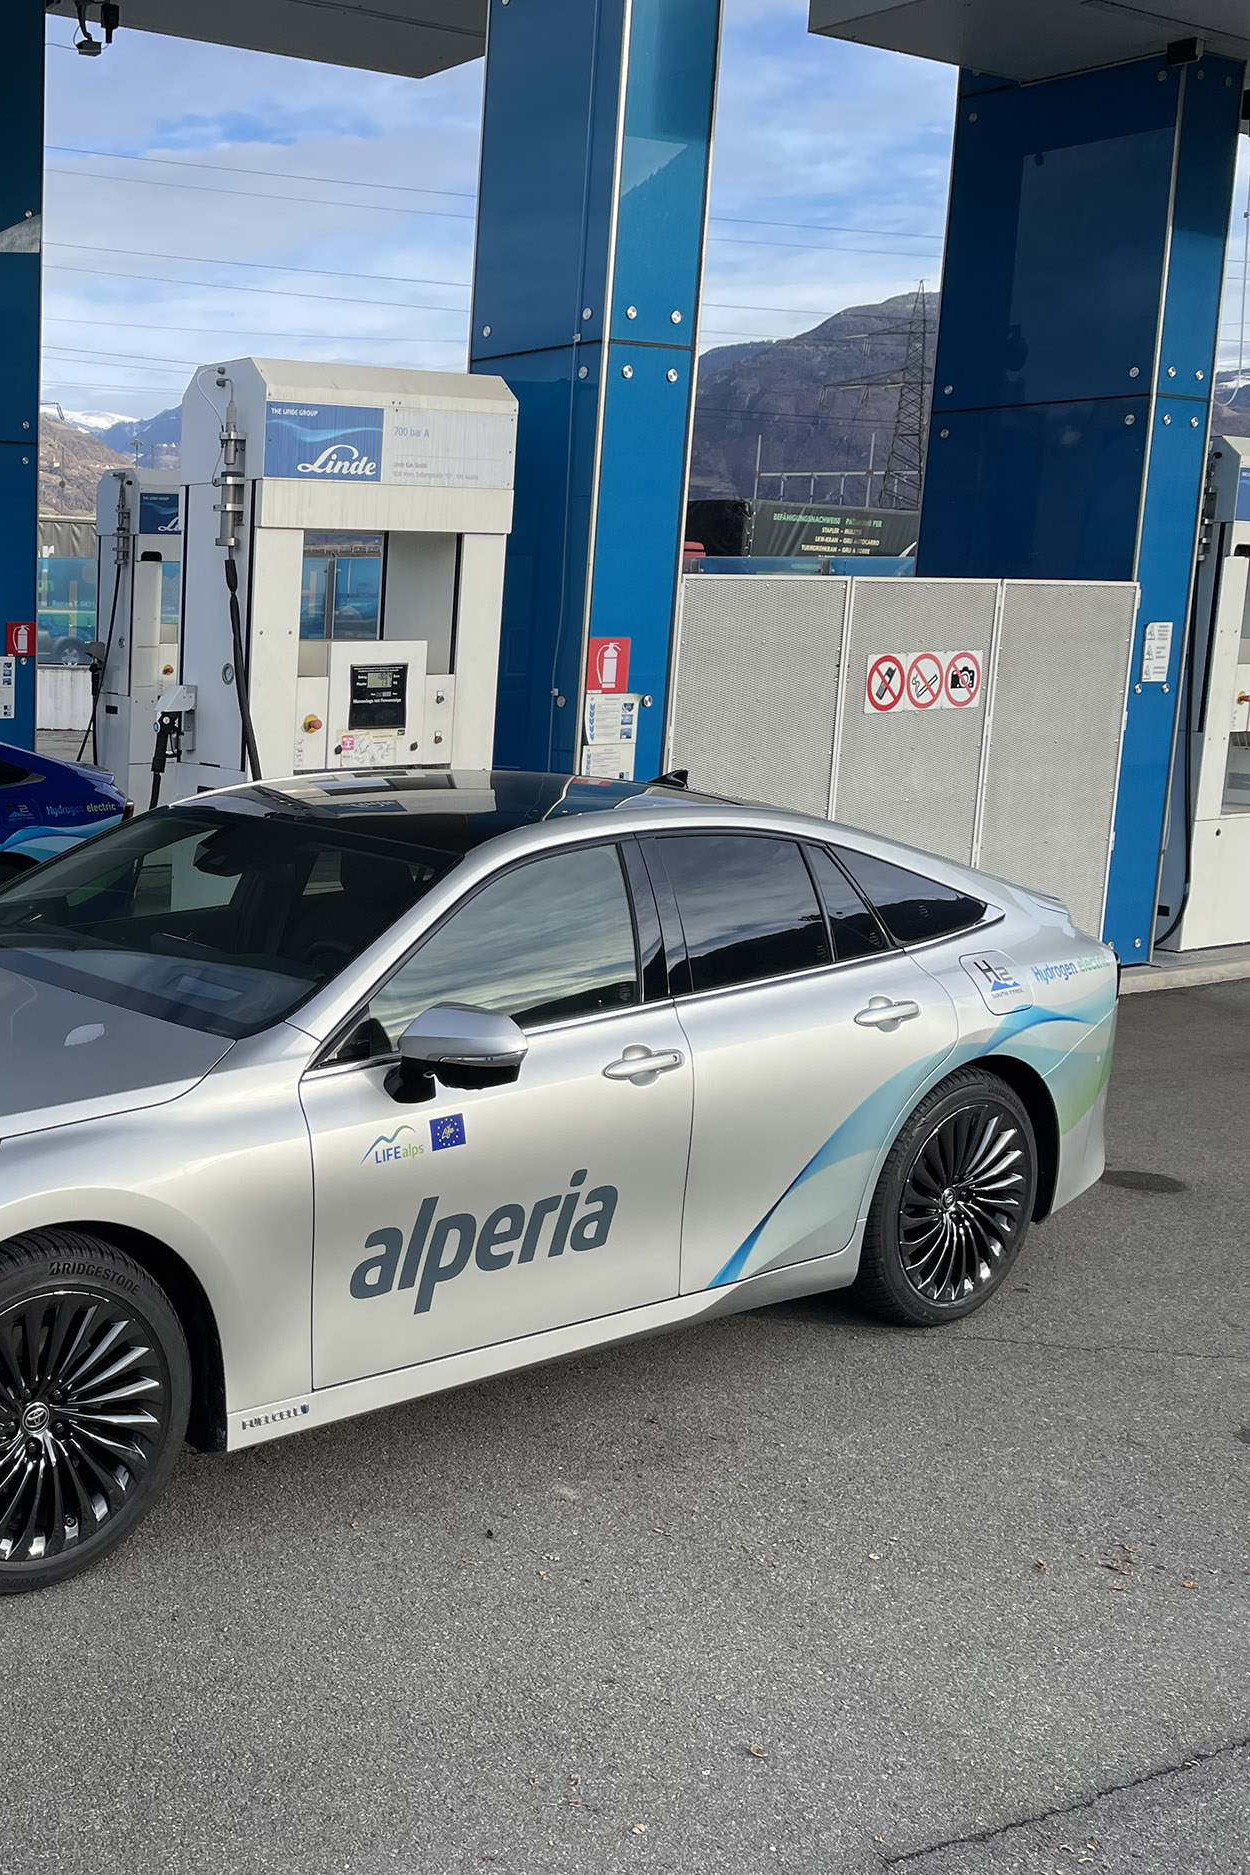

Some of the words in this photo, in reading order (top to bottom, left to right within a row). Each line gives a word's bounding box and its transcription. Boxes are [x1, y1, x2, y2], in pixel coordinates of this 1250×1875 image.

[271, 407, 282, 415] THE
[283, 408, 298, 416] LINDE
[299, 409, 318, 417] GROUP
[394, 426, 408, 437] 700
[410, 427, 422, 437] bar
[424, 428, 429, 438] A
[297, 444, 377, 476] Linde
[46, 804, 84, 818] Hydrogen
[86, 802, 117, 812] electric
[973, 960, 1013, 983] H2
[1031, 962, 1078, 984] Hydrogen
[1078, 955, 1110, 973] electric
[991, 990, 1008, 999] SOUTH
[1009, 988, 1025, 996] TYROL
[374, 1143, 424, 1165] LIFEalps
[349, 1168, 619, 1315] alperia
[49, 1262, 141, 1296] BRIDGESTONE
